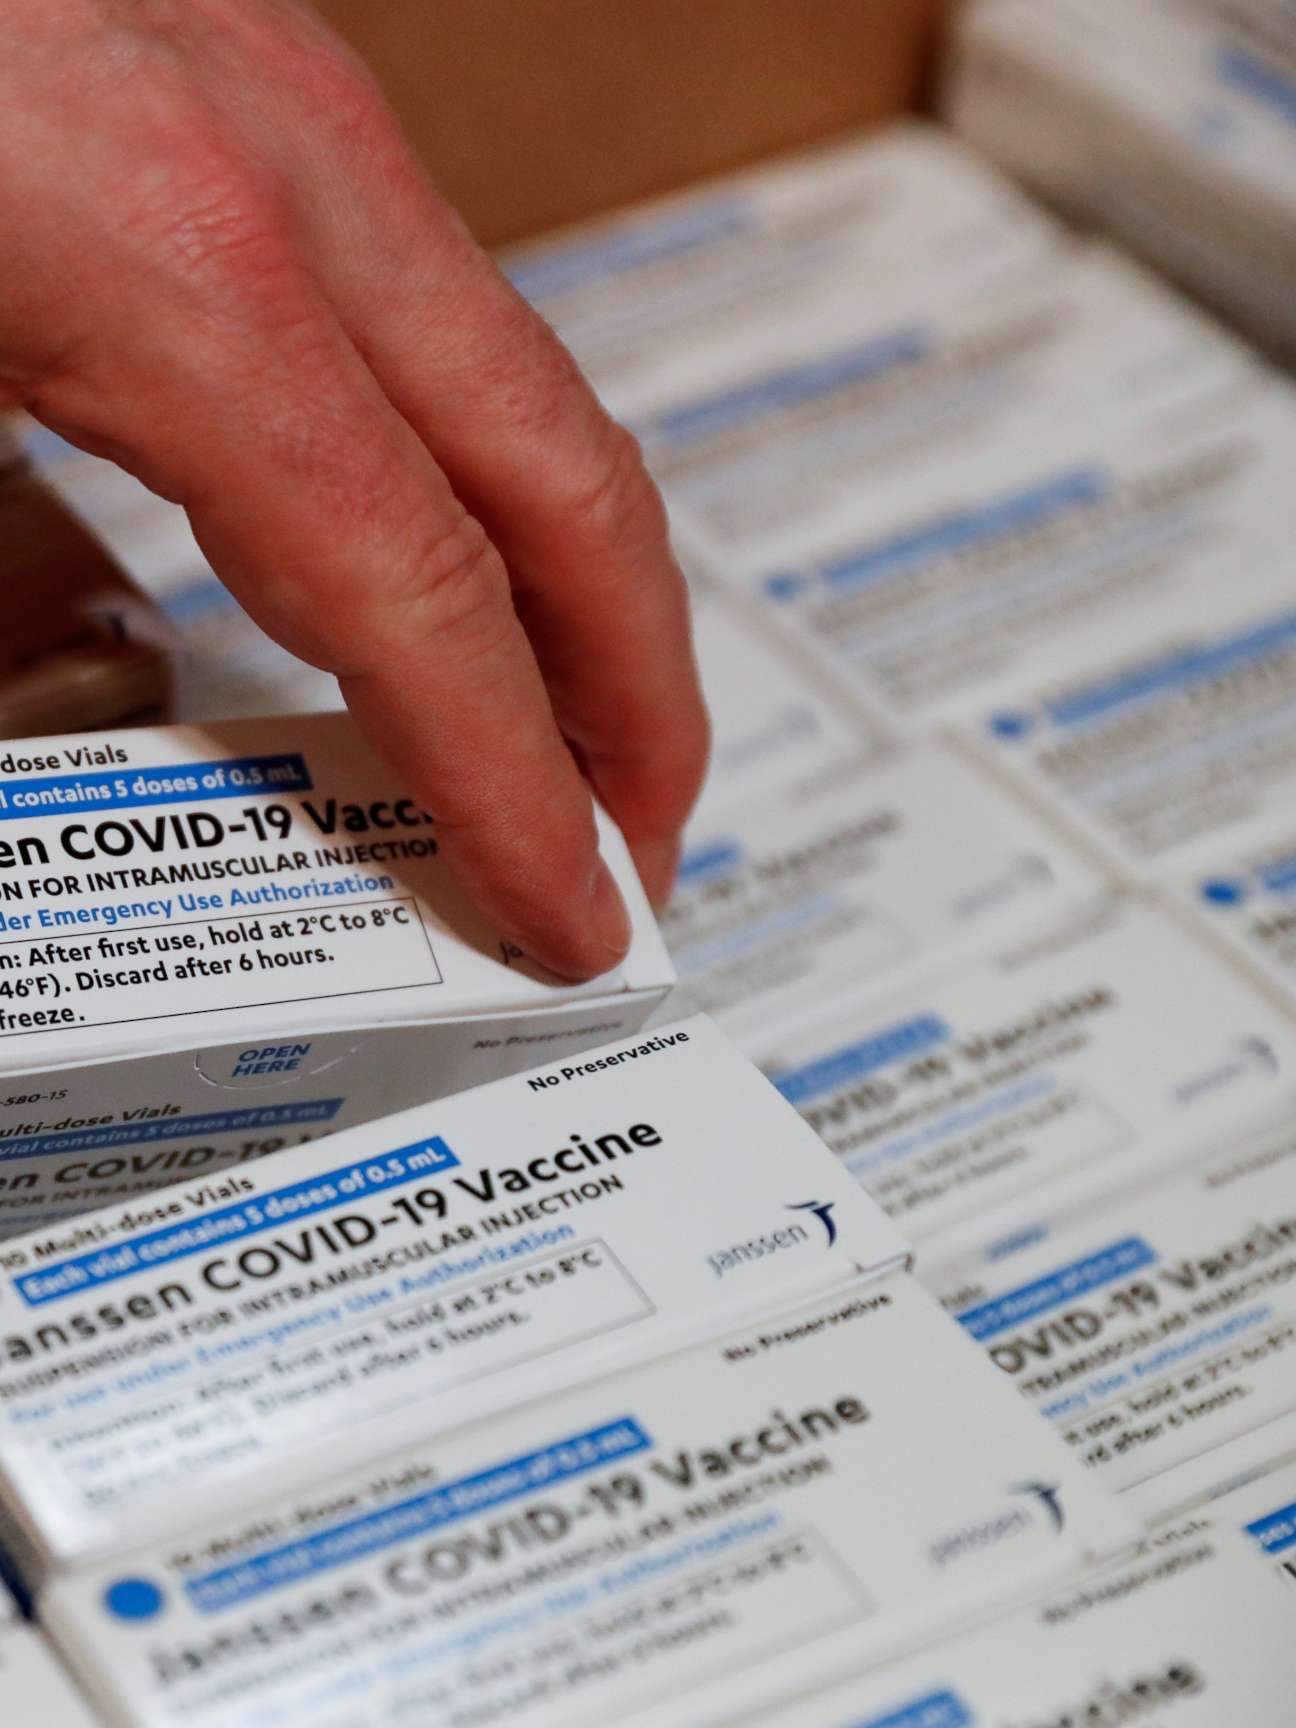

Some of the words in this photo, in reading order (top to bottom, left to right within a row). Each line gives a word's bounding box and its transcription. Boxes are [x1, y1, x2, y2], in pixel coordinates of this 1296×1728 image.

[62, 743, 129, 767] Vials
[11, 781, 112, 807] contains
[113, 778, 129, 798] 5
[131, 774, 199, 796] doses
[200, 767, 226, 789] of
[228, 766, 264, 786] 0.5
[59, 803, 292, 861] COVID-19
[301, 796, 436, 837] Vacc
[26, 874, 83, 898] FOR
[85, 850, 311, 892] INTRAMUSCULAR
[36, 898, 172, 928] Emergency
[176, 892, 224, 912] Use
[229, 871, 395, 906] Authorization
[27, 942, 92, 967] After
[96, 935, 151, 959] first
[153, 933, 205, 952] use,
[206, 919, 264, 946] hold
[268, 919, 295, 939] at
[295, 913, 337, 936] 2°C
[338, 913, 367, 931] to
[369, 904, 410, 927] 8°C
[74, 959, 169, 991] Discard
[173, 955, 233, 979] after
[238, 952, 254, 972] 6
[254, 947, 335, 970] hours.
[231, 1058, 300, 1077] HERE
[238, 1042, 312, 1062] OPEN
[527, 1074, 561, 1091] No
[560, 1031, 690, 1081] Preservative
[122, 1104, 183, 1121] Vials
[54, 1137, 288, 1184] COVID-19
[366, 1161, 405, 1183] 0.5
[406, 1149, 445, 1171] mL
[198, 1188, 447, 1293] COVID-19
[449, 1121, 663, 1204] Vaccine
[477, 1172, 625, 1235] INJECTION
[706, 1224, 807, 1278] janssen
[382, 1474, 644, 1595] COVID-19
[644, 1396, 871, 1490] Vaccine
